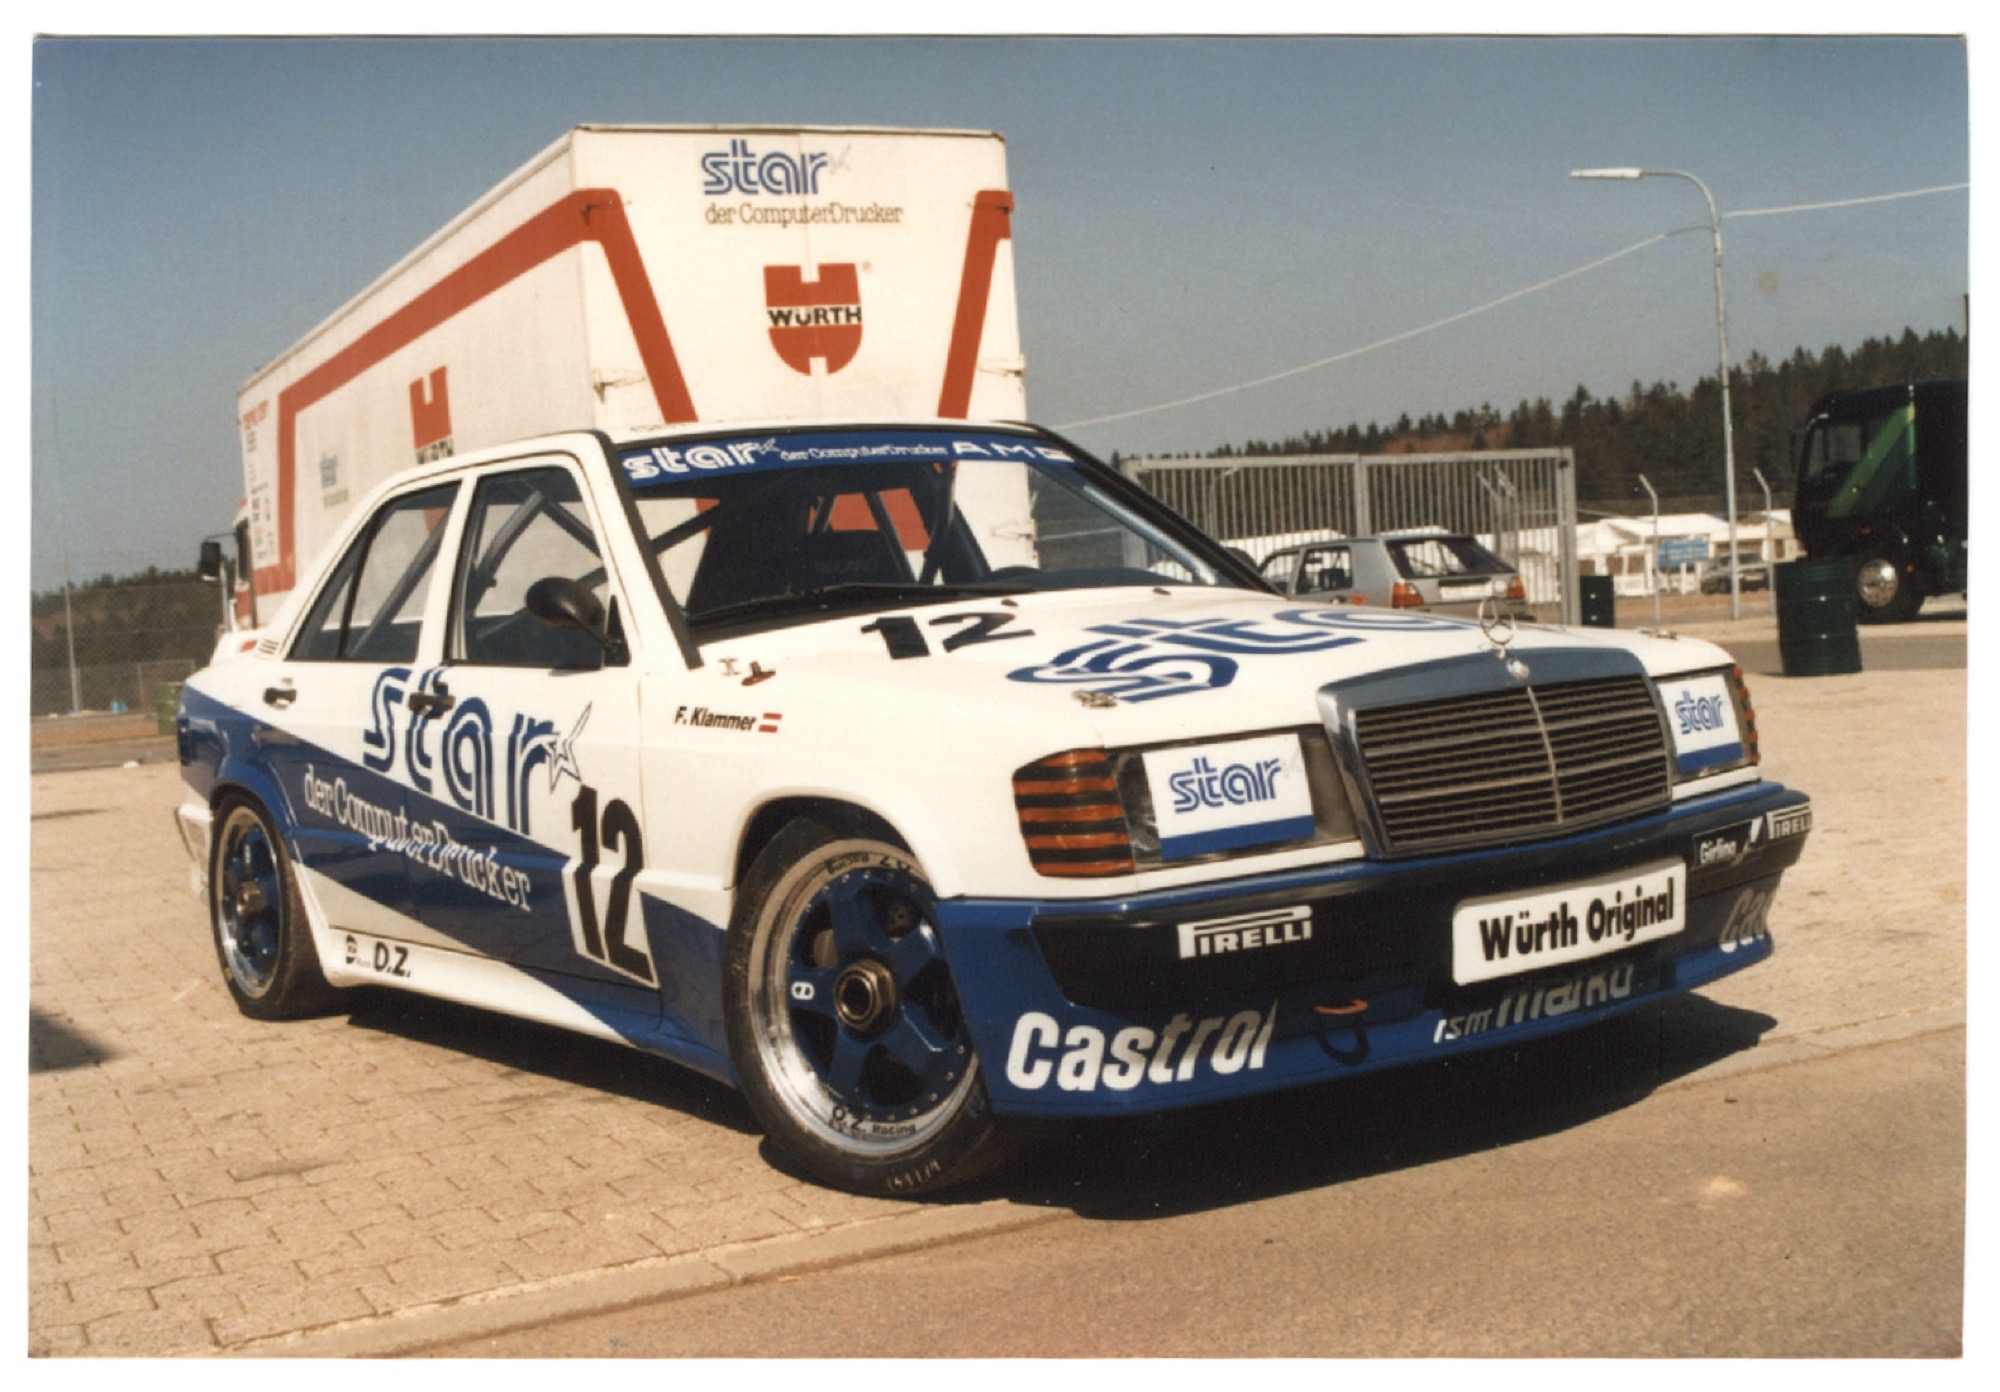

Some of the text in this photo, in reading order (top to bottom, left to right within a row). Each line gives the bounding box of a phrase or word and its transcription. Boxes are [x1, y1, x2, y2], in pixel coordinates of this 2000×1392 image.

[701, 139, 827, 195] star
[705, 202, 903, 228] der ComputerDrucker
[767, 306, 861, 328] WÜRTH
[623, 444, 758, 481] star
[860, 612, 1036, 660] 12
[673, 705, 757, 731] F. Klammer
[1675, 690, 1723, 735] star
[363, 667, 560, 837] star
[1170, 757, 1281, 813] star
[304, 763, 532, 912] der ComputerDrucker
[571, 784, 654, 984] 12
[1177, 905, 1313, 959] PIRELLI
[1479, 877, 1674, 961] Würth Original
[1006, 1000, 1278, 1092] Castrol
[872, 1122, 916, 1137] Racing
